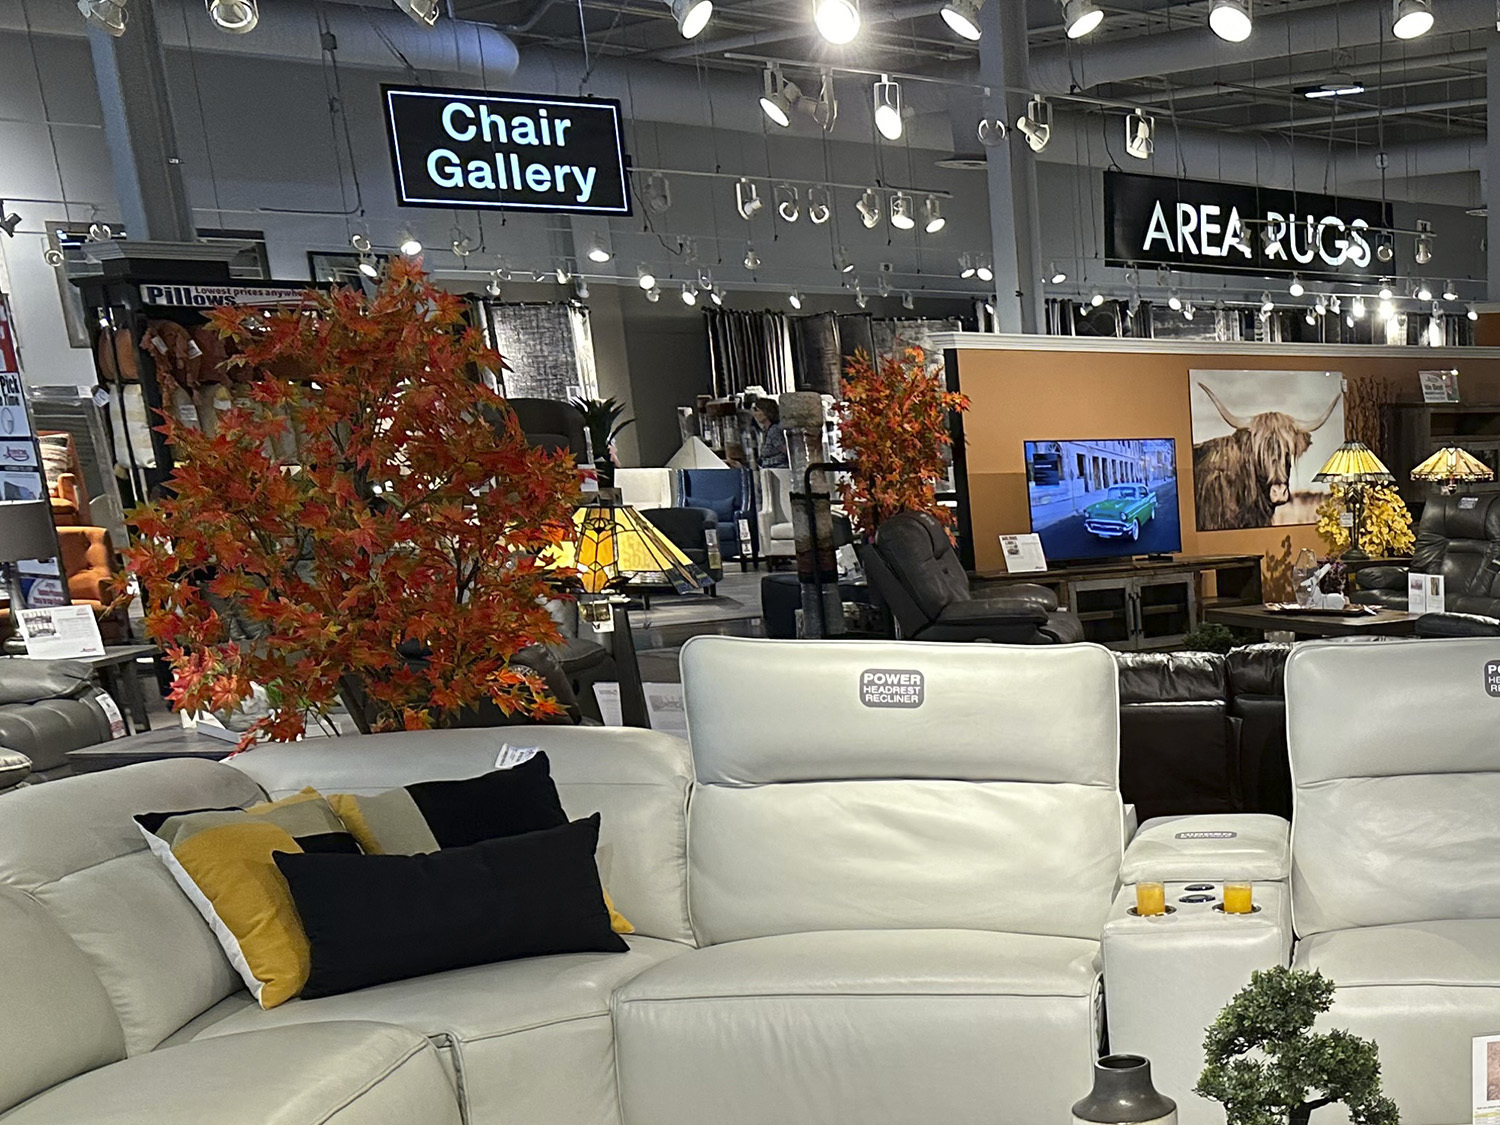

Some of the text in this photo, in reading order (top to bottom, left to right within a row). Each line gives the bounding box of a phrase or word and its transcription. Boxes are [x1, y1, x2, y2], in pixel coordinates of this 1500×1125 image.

[442, 102, 571, 147] Chair
[427, 149, 596, 203] Gallery
[1142, 200, 1372, 268] AREA RUGS
[146, 286, 237, 306] Pillows
[195, 286, 231, 295] Lowest
[233, 288, 263, 297] prices
[863, 673, 921, 685] POWER
[863, 685, 921, 694] HEADREST
[865, 694, 919, 703] RECLINER
